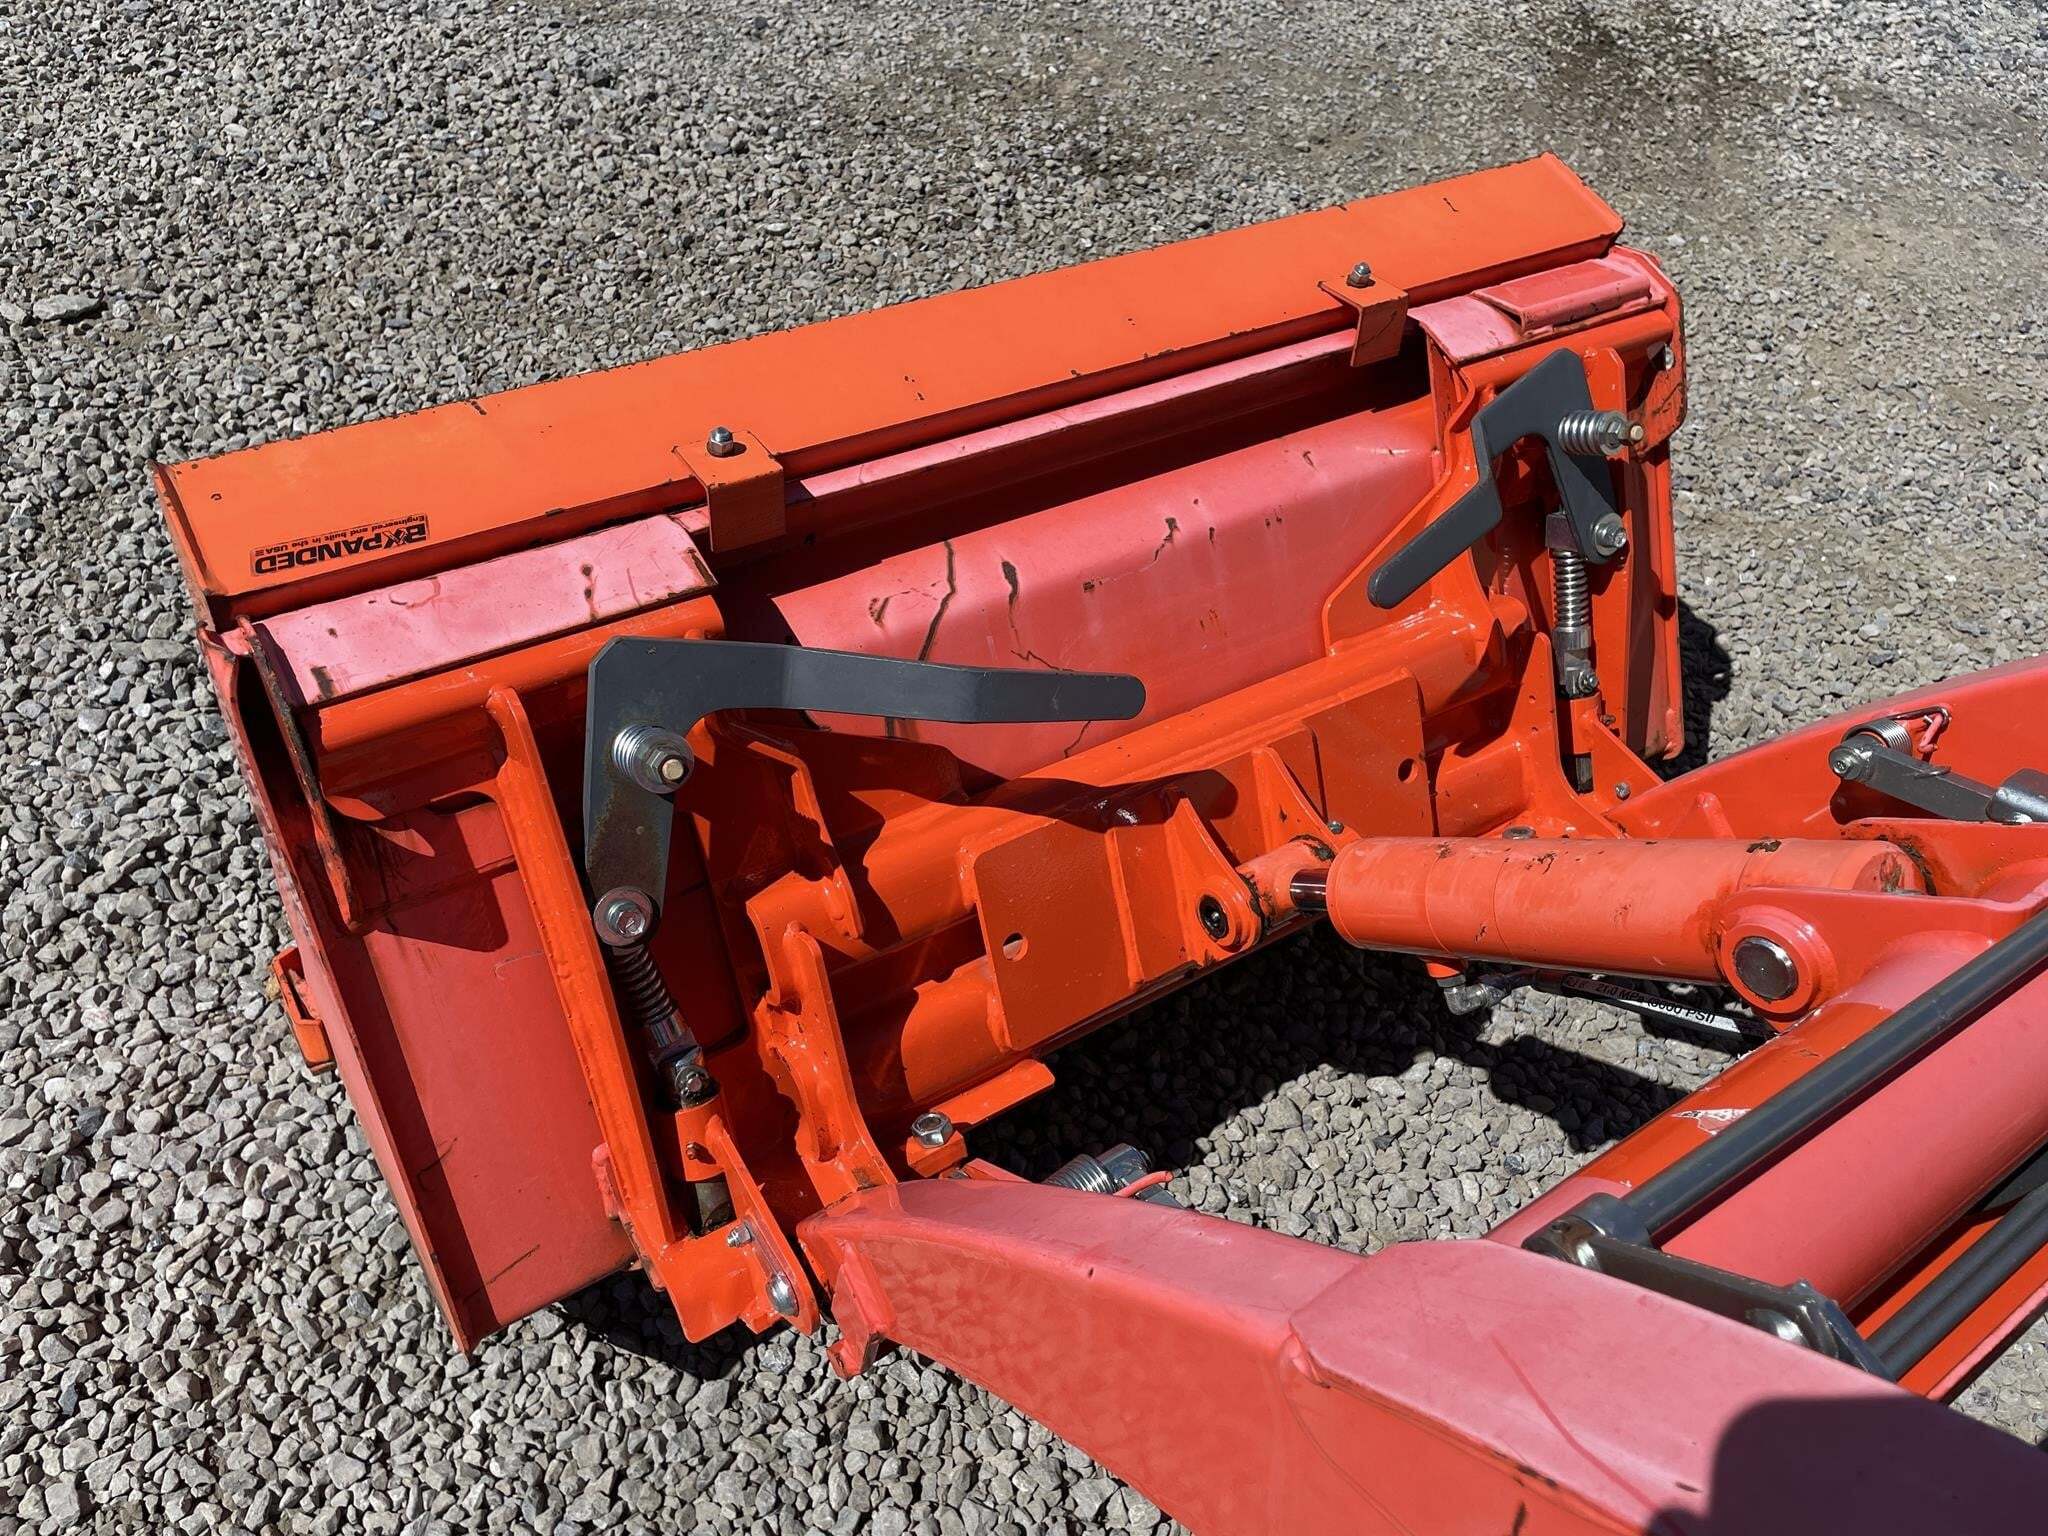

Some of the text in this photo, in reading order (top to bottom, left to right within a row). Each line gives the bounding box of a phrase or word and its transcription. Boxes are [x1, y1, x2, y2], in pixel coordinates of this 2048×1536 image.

[372, 515, 425, 533] Engineered
[324, 531, 348, 542] built
[350, 526, 369, 537] and
[255, 522, 427, 574] BXPANDED
[265, 544, 289, 555] USA
[291, 540, 309, 549] the
